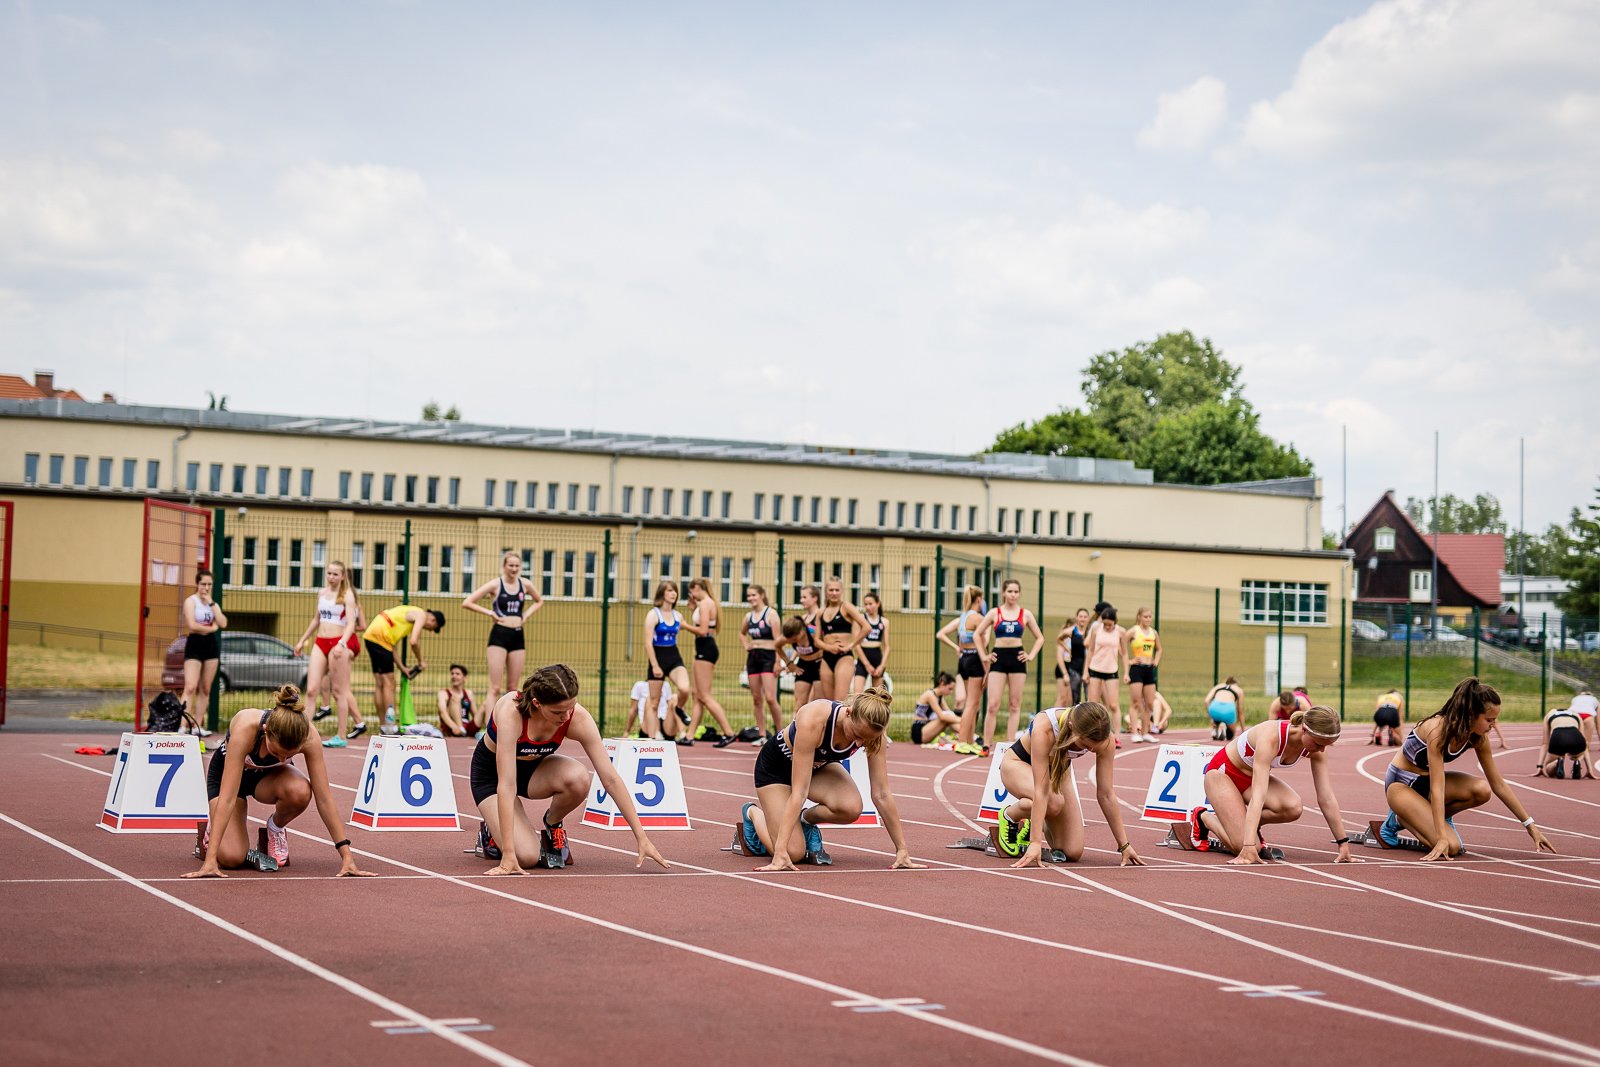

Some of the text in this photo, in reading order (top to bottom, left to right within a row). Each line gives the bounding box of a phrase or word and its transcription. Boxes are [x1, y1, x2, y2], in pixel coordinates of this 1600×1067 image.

[155, 740, 186, 749] polanik
[406, 743, 434, 751] polanik
[112, 752, 129, 805] 7
[148, 753, 185, 808] 7
[364, 754, 379, 805] 6
[400, 756, 433, 807] 6
[634, 758, 665, 807] 5
[1158, 760, 1181, 803] 2
